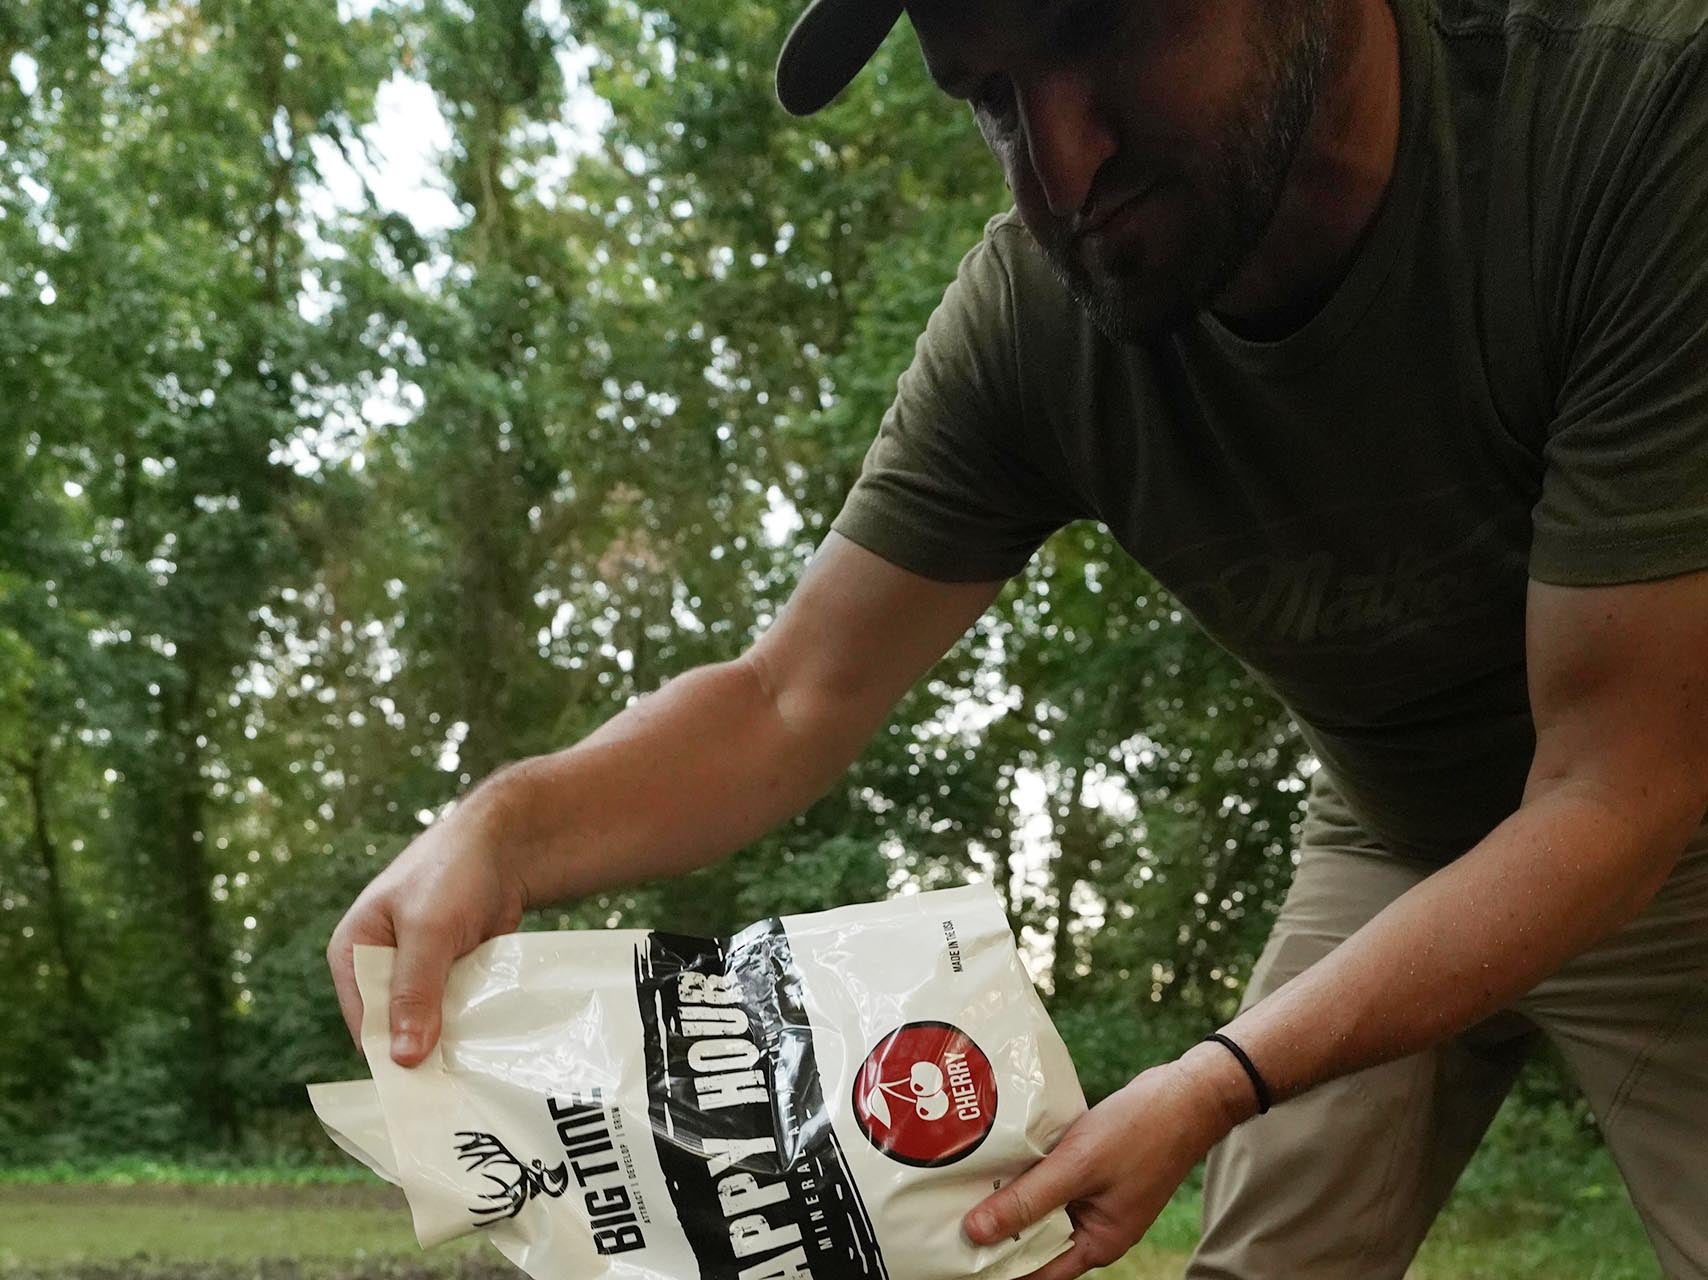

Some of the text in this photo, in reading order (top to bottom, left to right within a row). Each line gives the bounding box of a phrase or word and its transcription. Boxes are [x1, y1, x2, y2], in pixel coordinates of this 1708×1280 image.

[942, 919, 963, 973] MADE IN THE USA
[677, 970, 770, 1111] HOUR
[943, 1052, 981, 1121] CHERRY
[547, 1088, 646, 1255] BIG TINE
[611, 1106, 651, 1225] ATTRACT DEVELOP GROW
[797, 1148, 834, 1251] MINERAL
